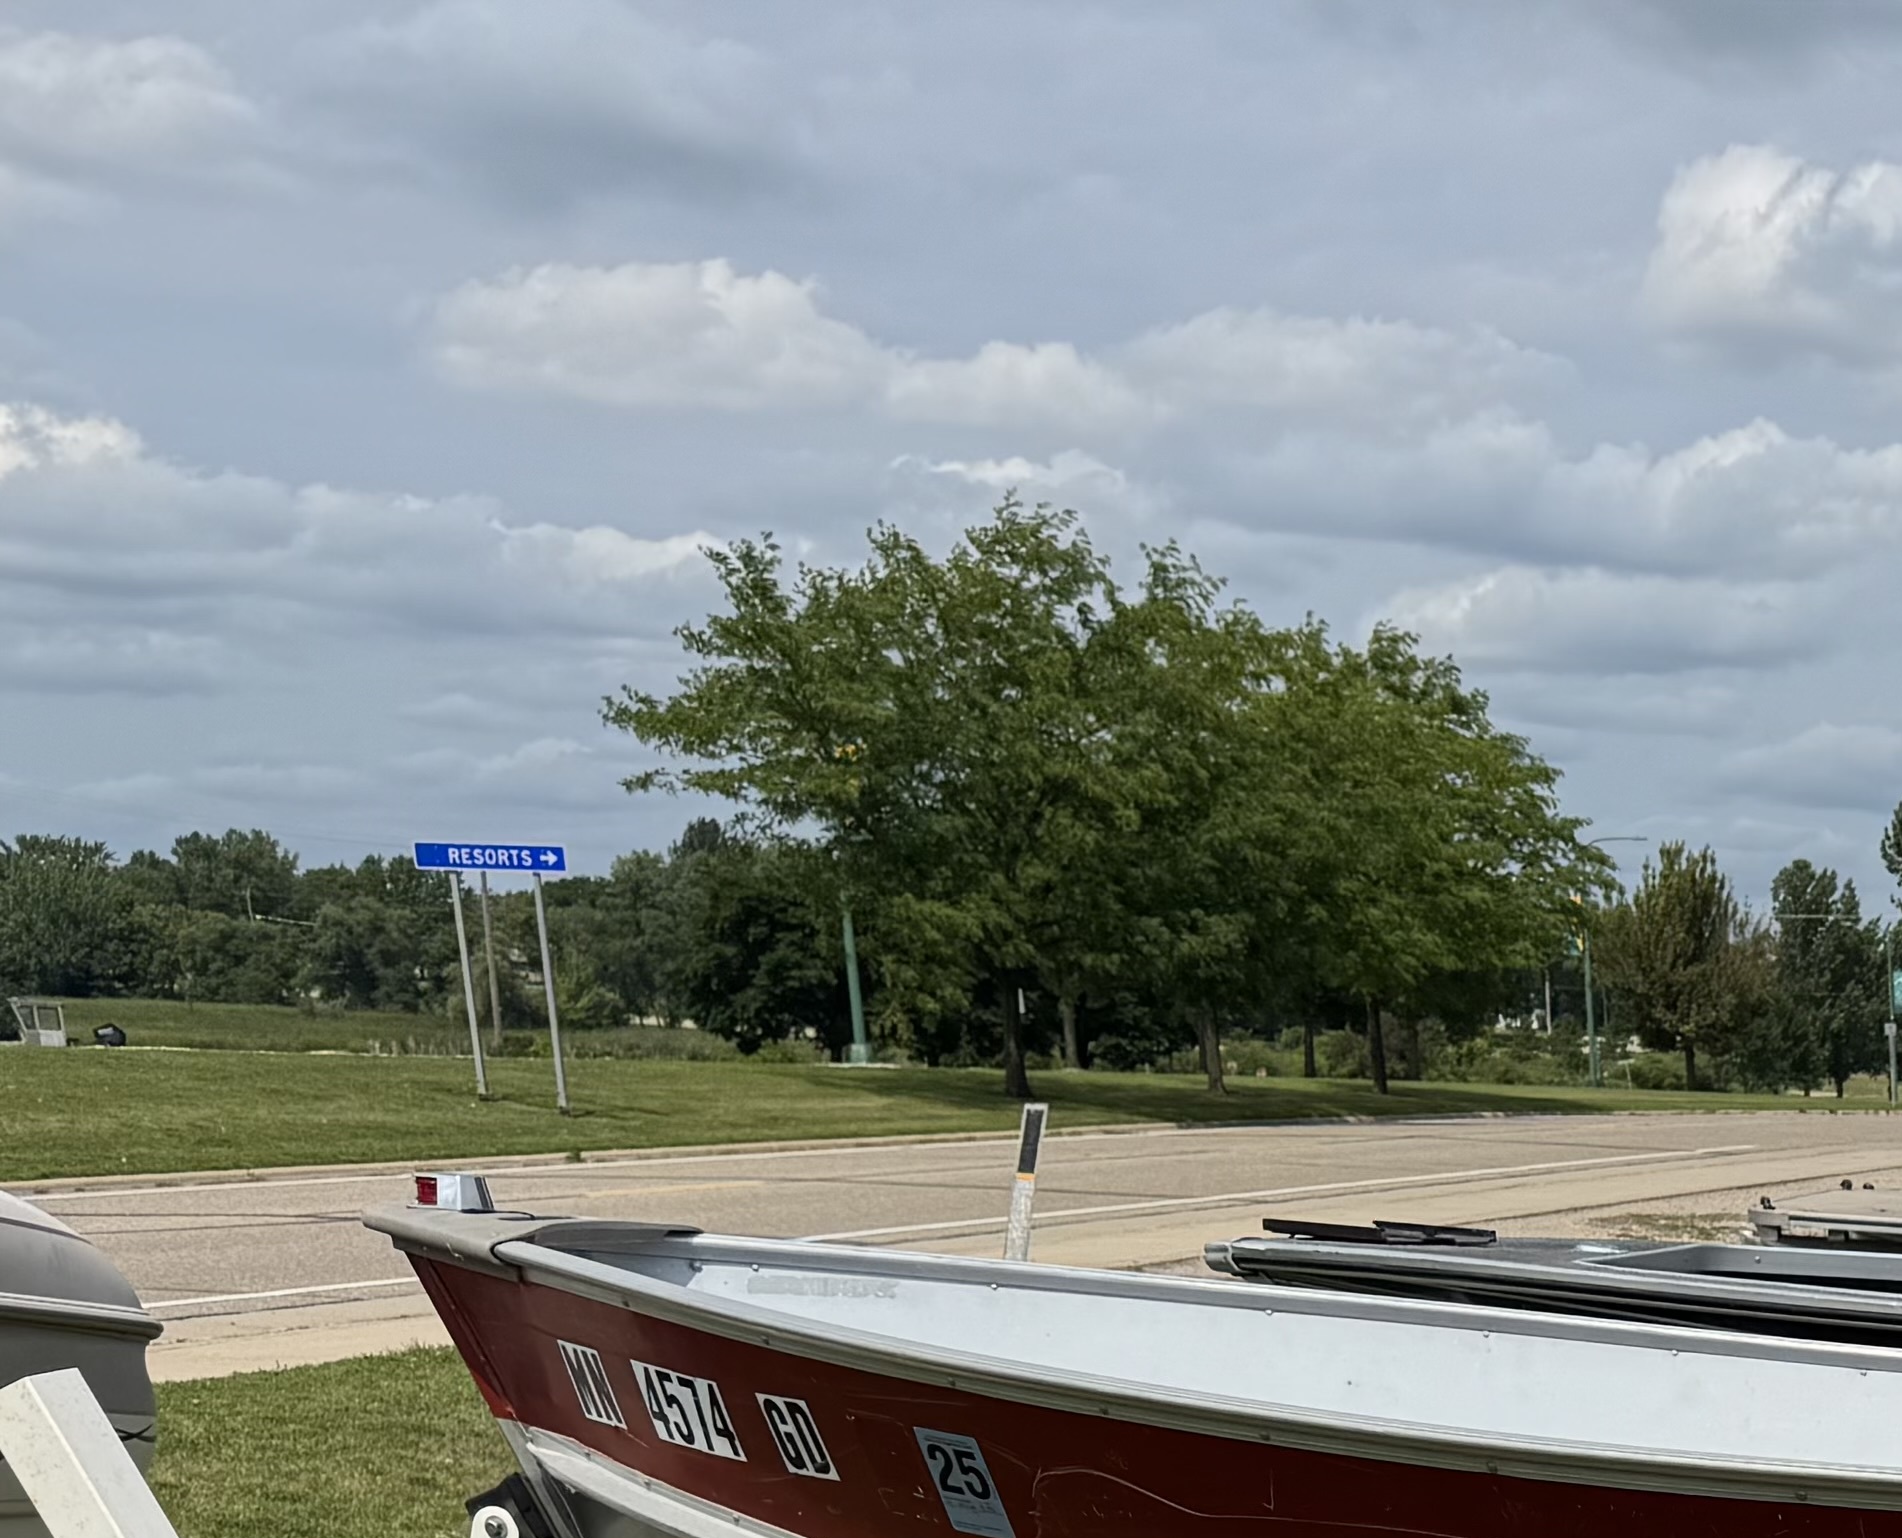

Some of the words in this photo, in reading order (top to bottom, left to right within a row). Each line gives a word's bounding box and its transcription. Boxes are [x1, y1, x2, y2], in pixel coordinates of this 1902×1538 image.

[448, 847, 533, 867] RESORTS
[561, 1344, 622, 1424] MN
[643, 1366, 741, 1458] 4574
[762, 1398, 831, 1475] GD
[927, 1443, 991, 1500] 25
